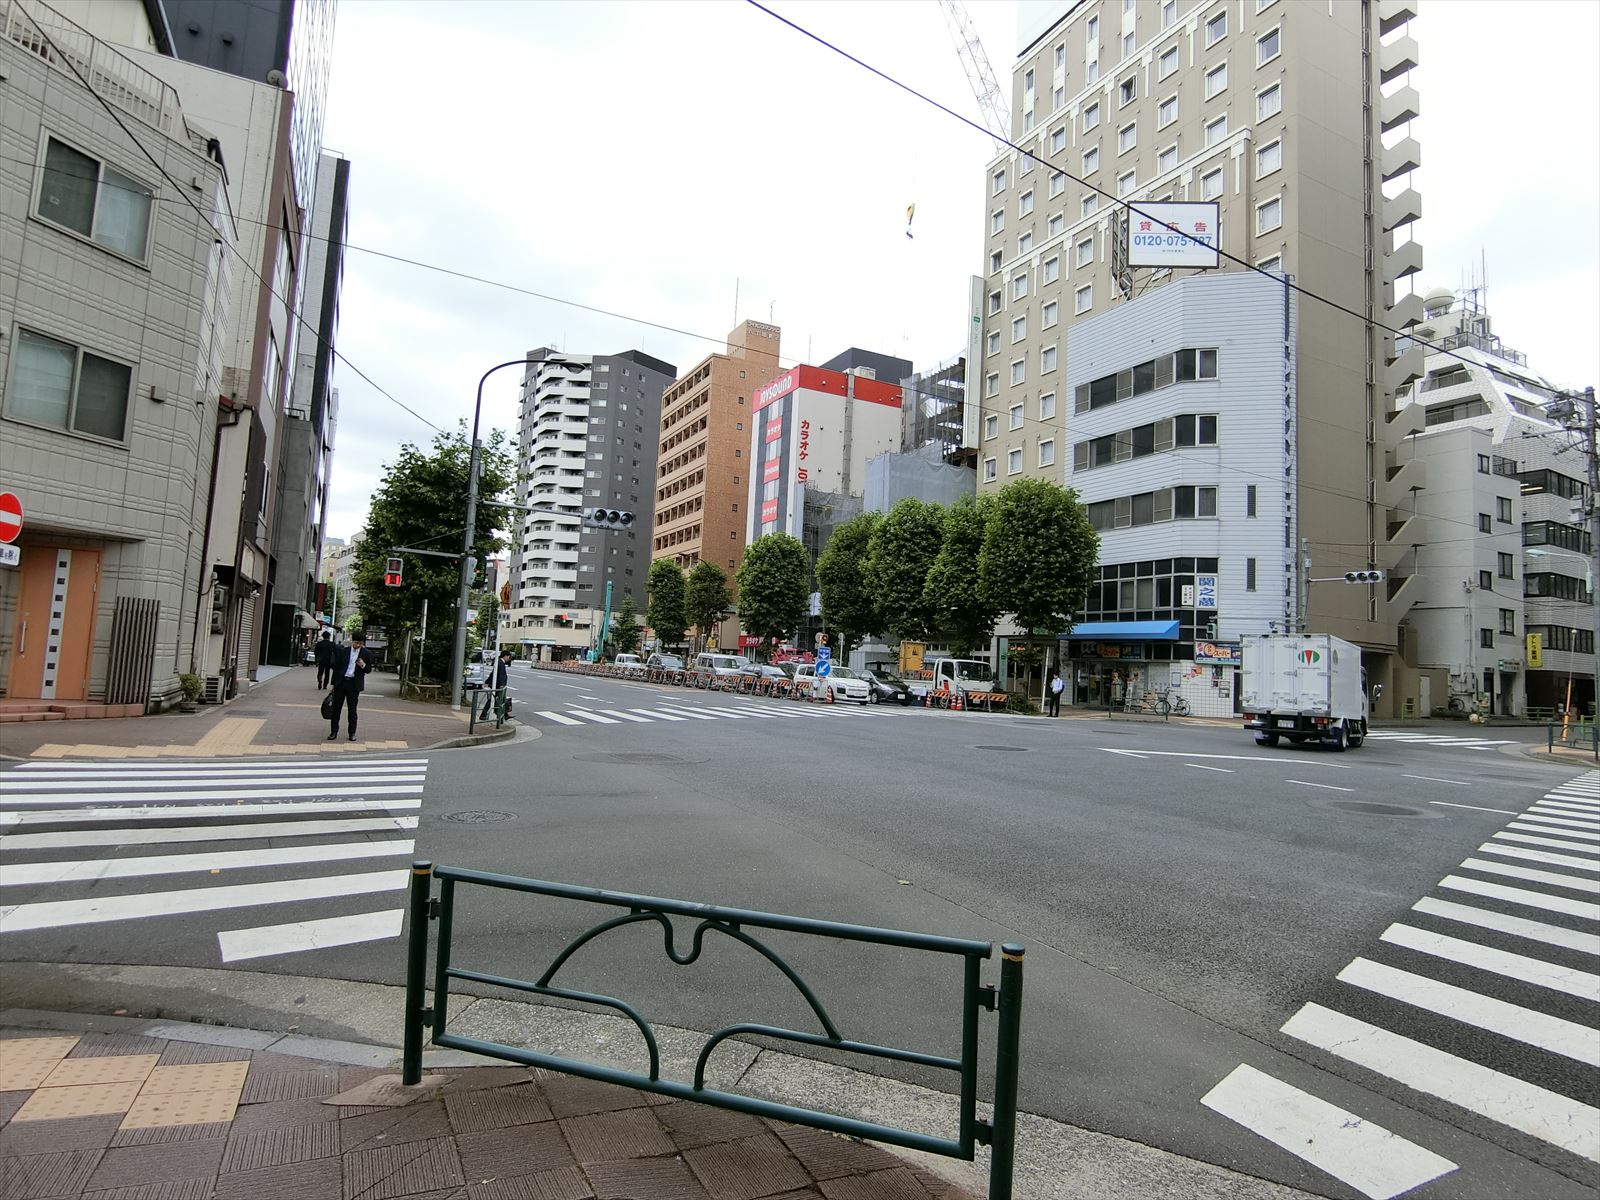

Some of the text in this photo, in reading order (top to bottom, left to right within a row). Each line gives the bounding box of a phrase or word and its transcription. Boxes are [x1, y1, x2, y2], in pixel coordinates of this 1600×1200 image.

[759, 375, 792, 405] JOYSOUND
[799, 419, 810, 460] カラオケ
